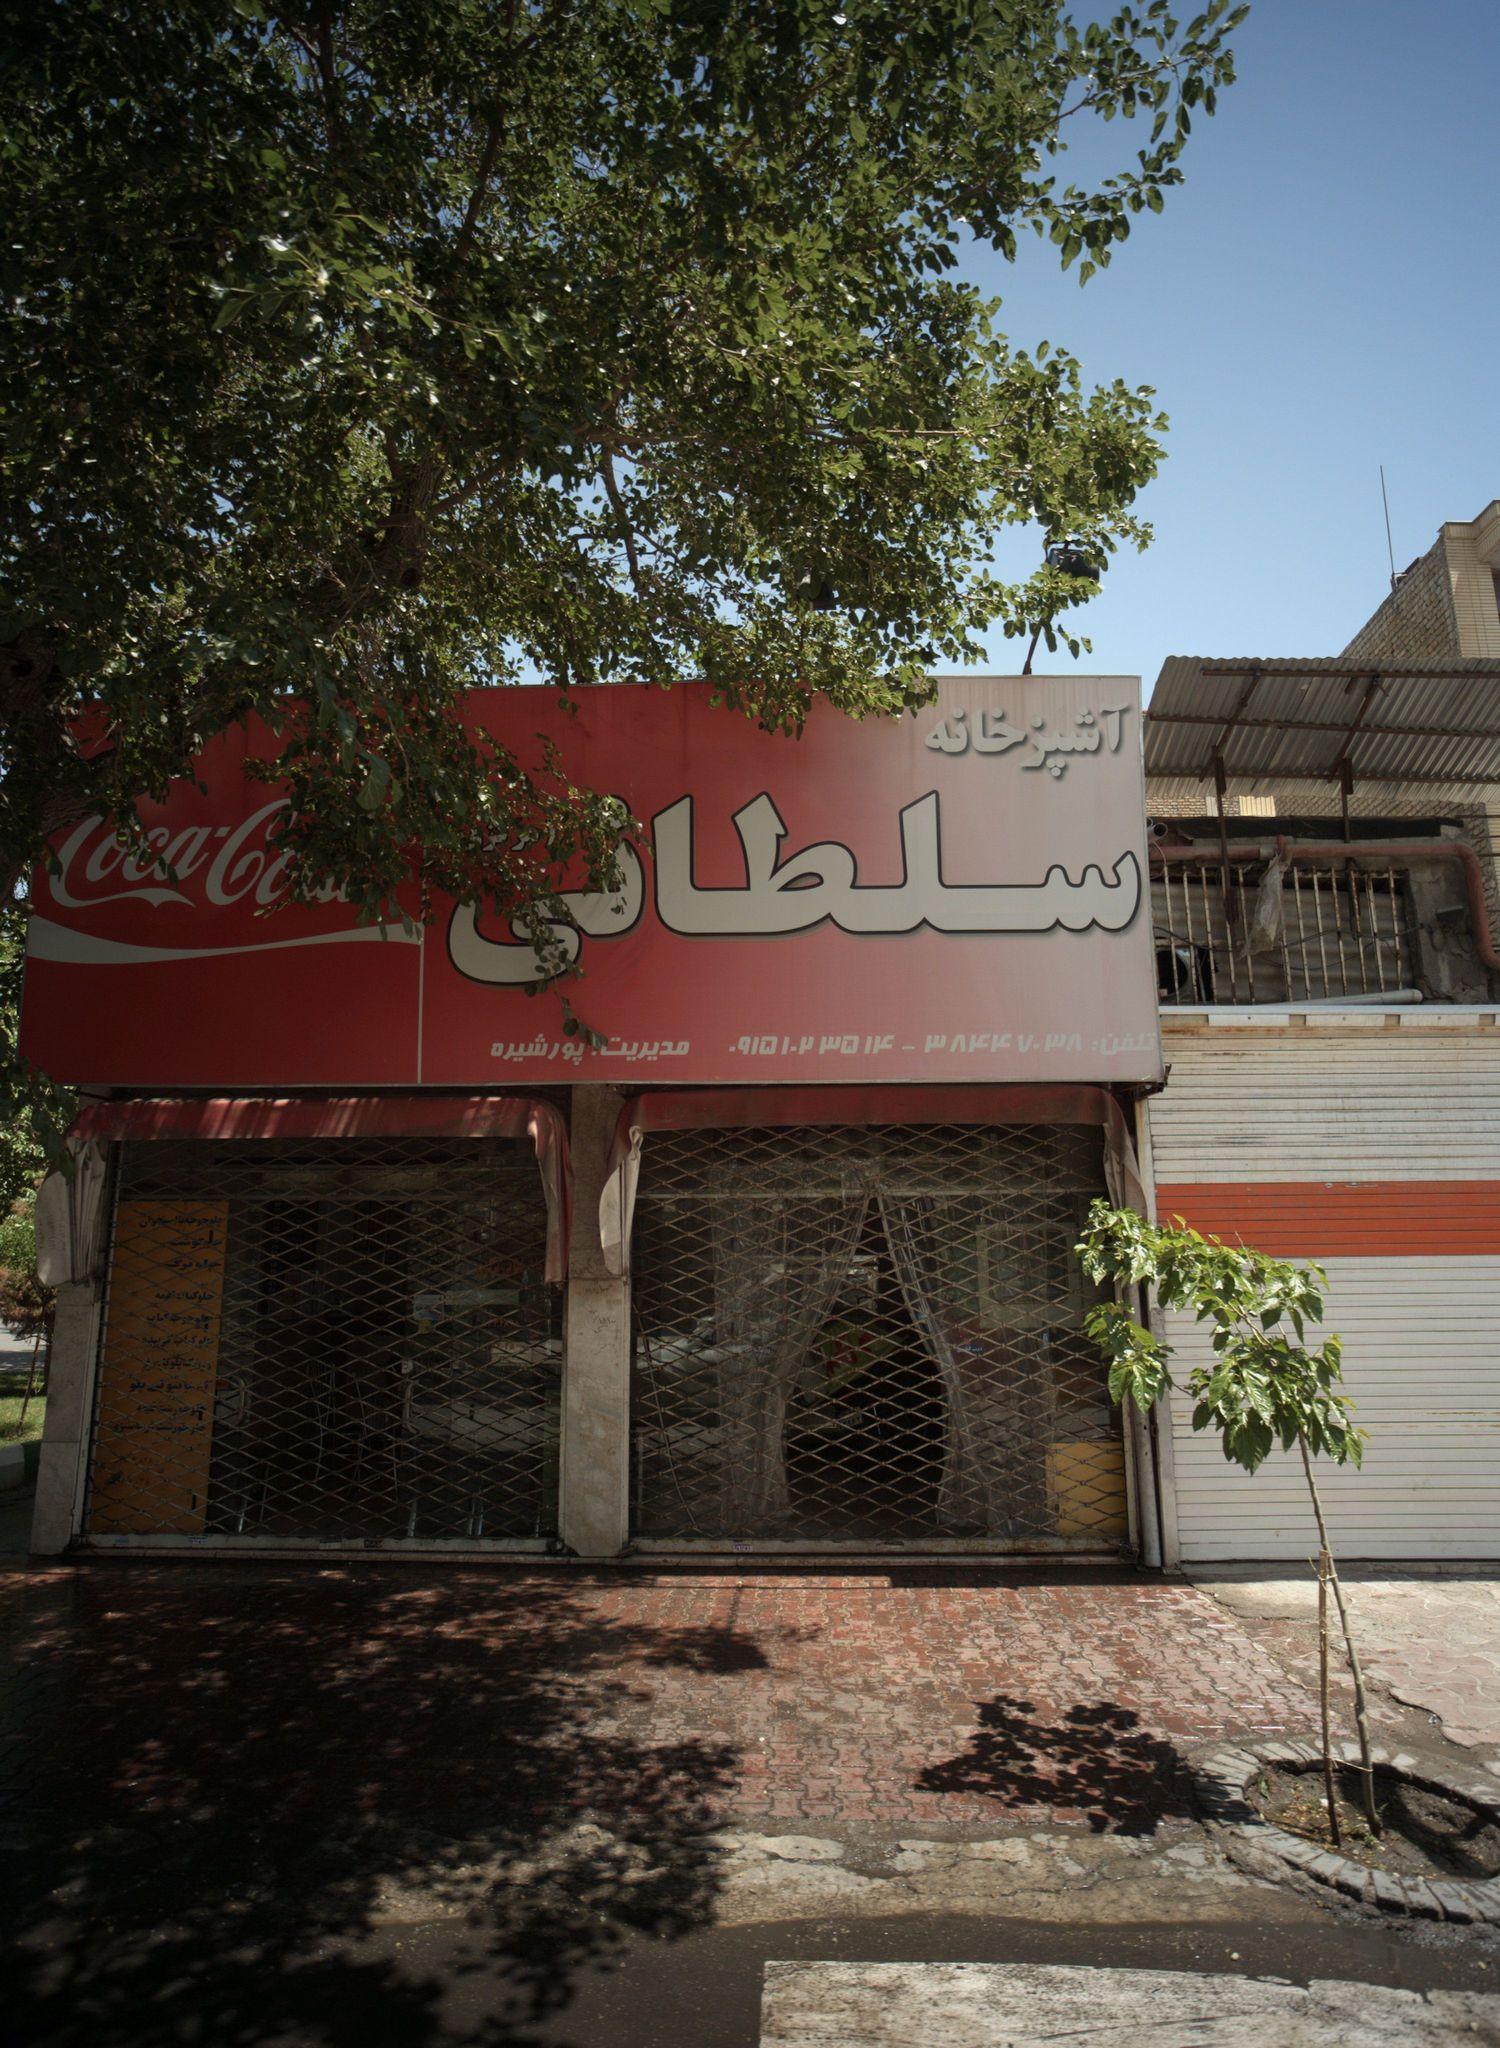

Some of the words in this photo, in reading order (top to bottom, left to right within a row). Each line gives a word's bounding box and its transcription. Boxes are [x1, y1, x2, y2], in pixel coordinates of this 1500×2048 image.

[924, 703, 1129, 777] آشپزخانه
[48, 797, 351, 908] Coca-Co
[447, 790, 1142, 986] سلطانی
